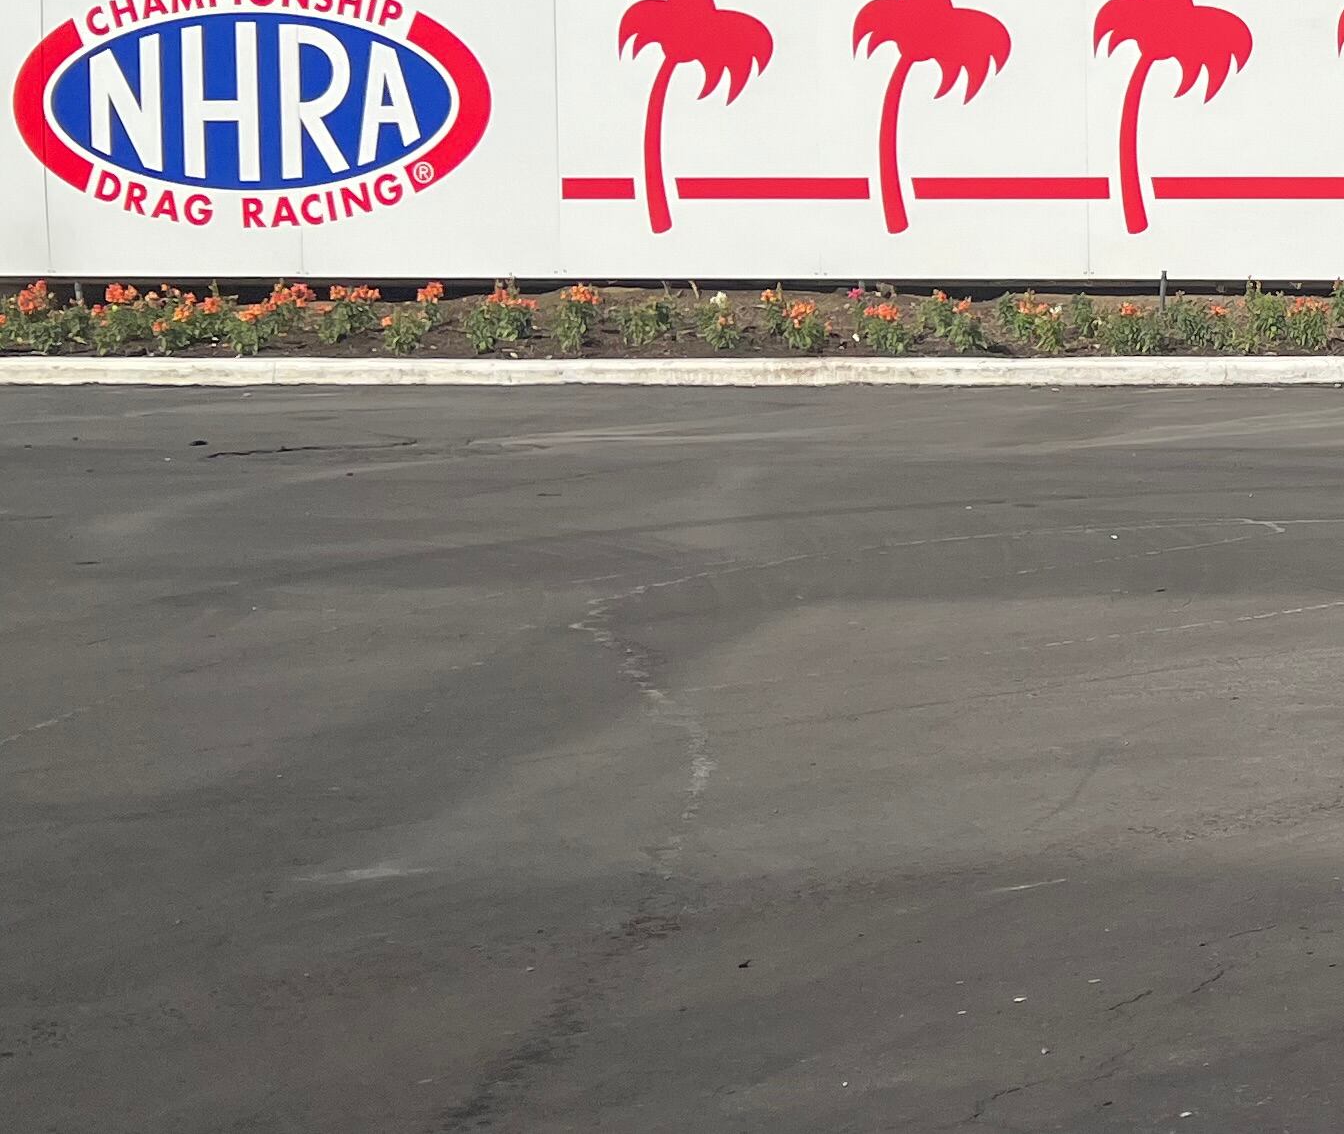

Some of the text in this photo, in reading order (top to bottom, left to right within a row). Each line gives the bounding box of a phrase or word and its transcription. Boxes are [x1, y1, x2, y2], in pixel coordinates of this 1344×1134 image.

[89, 21, 421, 182] NHRA
[94, 170, 404, 229] DRAG RACING
